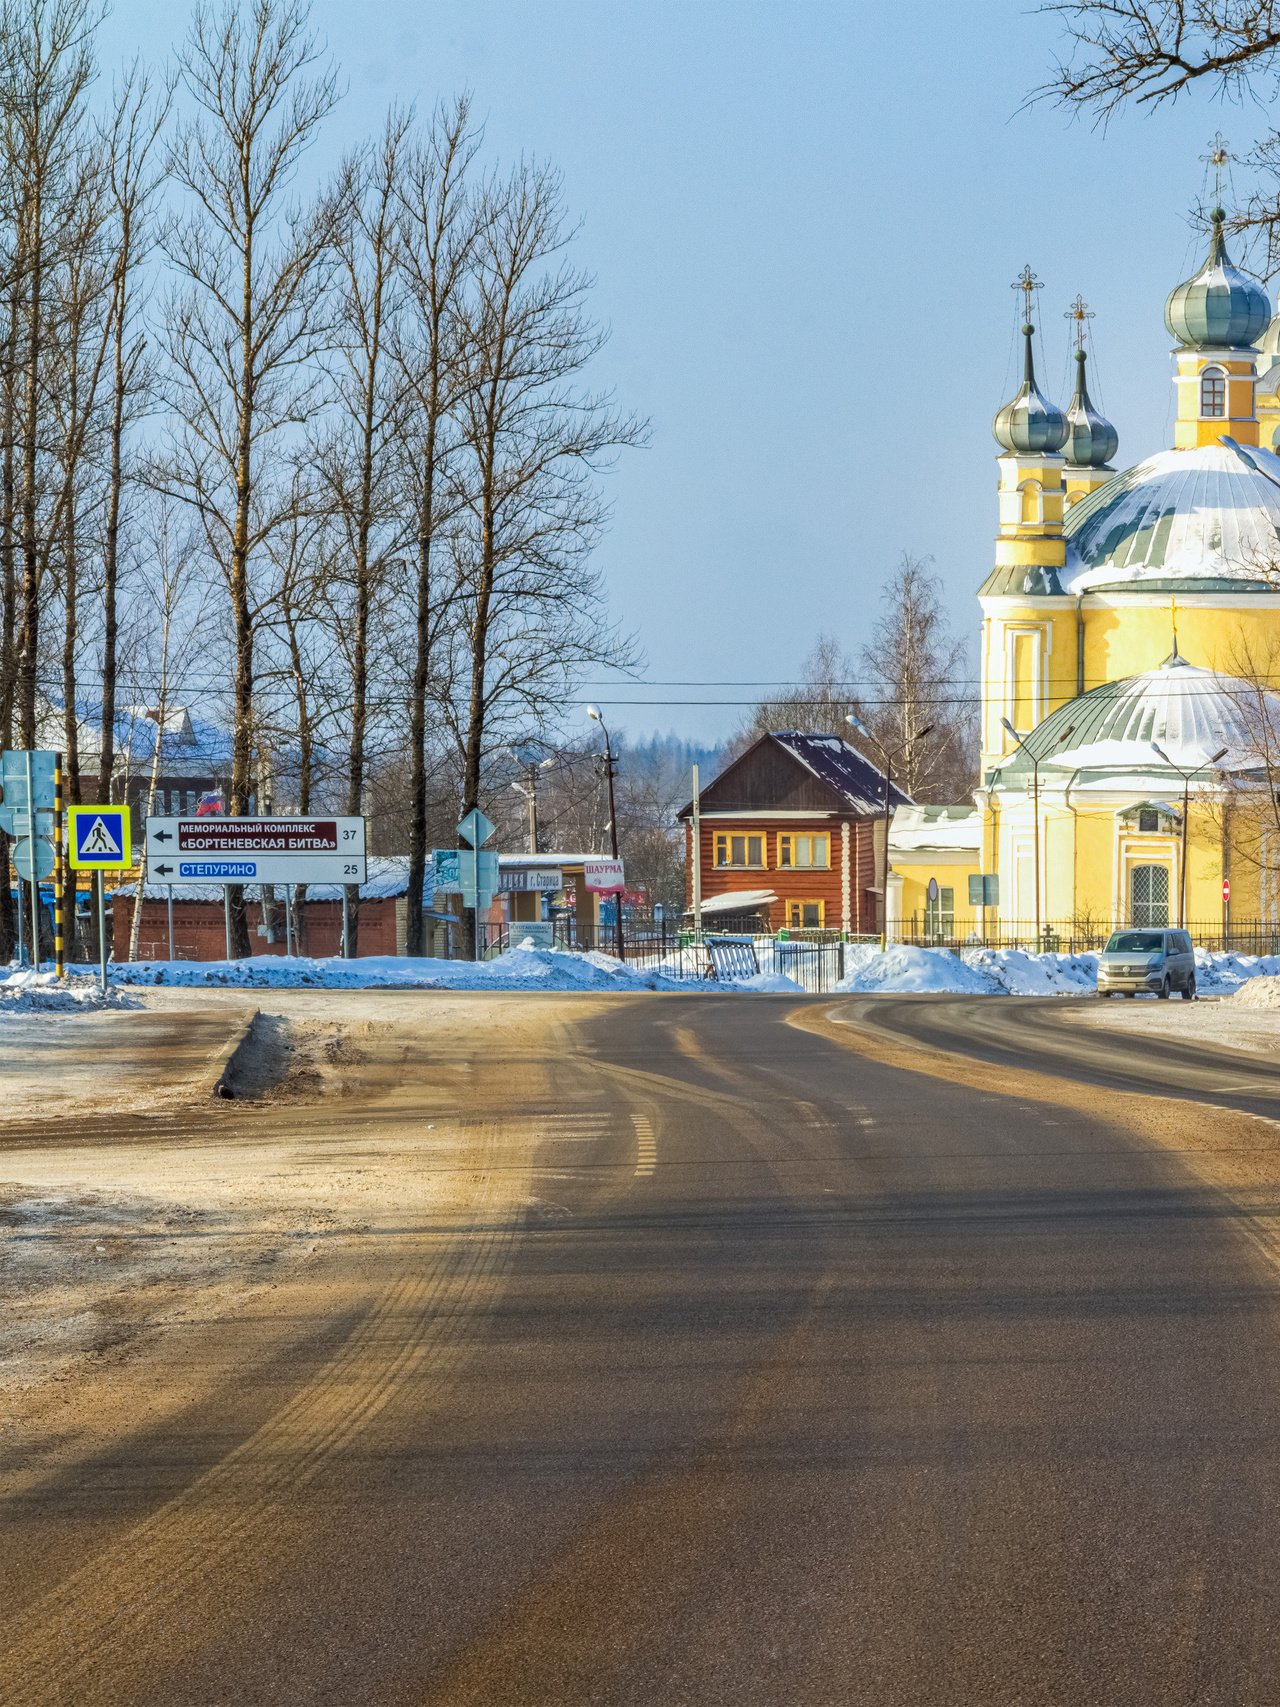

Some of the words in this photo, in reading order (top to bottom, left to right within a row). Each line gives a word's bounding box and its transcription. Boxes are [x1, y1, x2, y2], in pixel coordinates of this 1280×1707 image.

[180, 823, 262, 833] МЕМОРИАЛЬНЫЙ
[264, 824, 316, 833] КОМПЛЕКС
[343, 830, 357, 840] 37
[181, 838, 285, 849] «БОРТЕНЕВСКАЯ
[288, 838, 336, 849] БИТВА»
[181, 864, 255, 875] СТЕПУРИНО
[343, 865, 358, 875] 25
[586, 865, 622, 874] ШАУРМА
[537, 873, 559, 889] Старица
